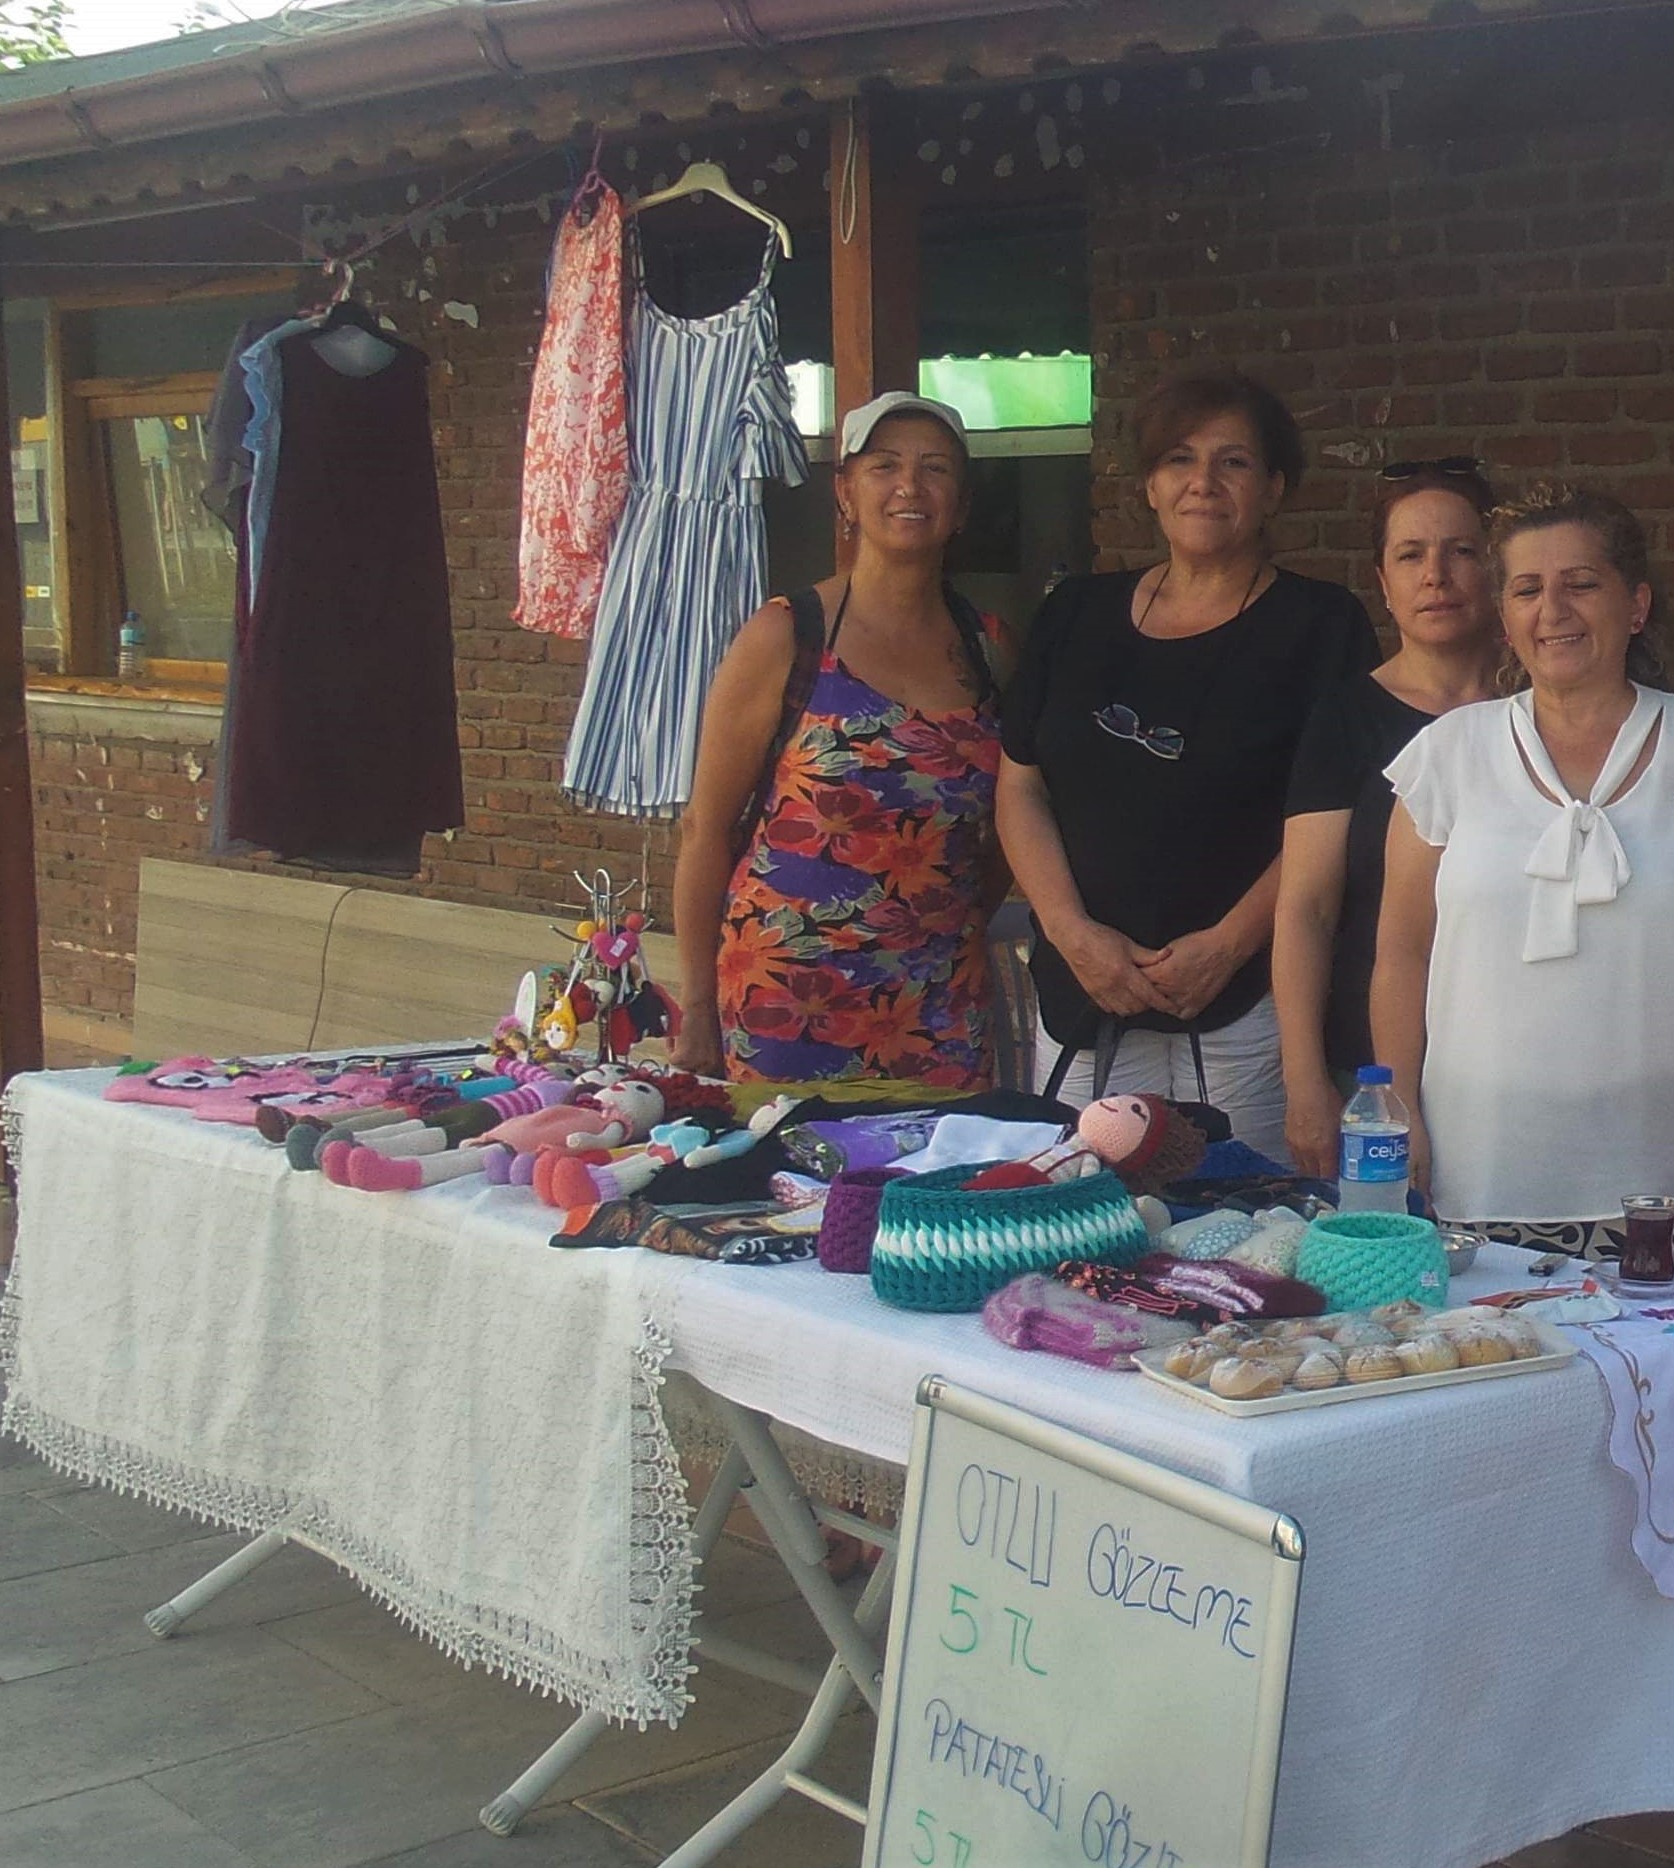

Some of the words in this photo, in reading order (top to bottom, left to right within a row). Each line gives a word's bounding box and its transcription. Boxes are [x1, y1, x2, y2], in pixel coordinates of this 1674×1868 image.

[956, 1463, 1057, 1588] OTLU
[1087, 1522, 1257, 1658] GÖZLEME
[939, 1583, 979, 1655] 5
[1003, 1607, 1048, 1676] TL
[911, 1808, 937, 1866] 5
